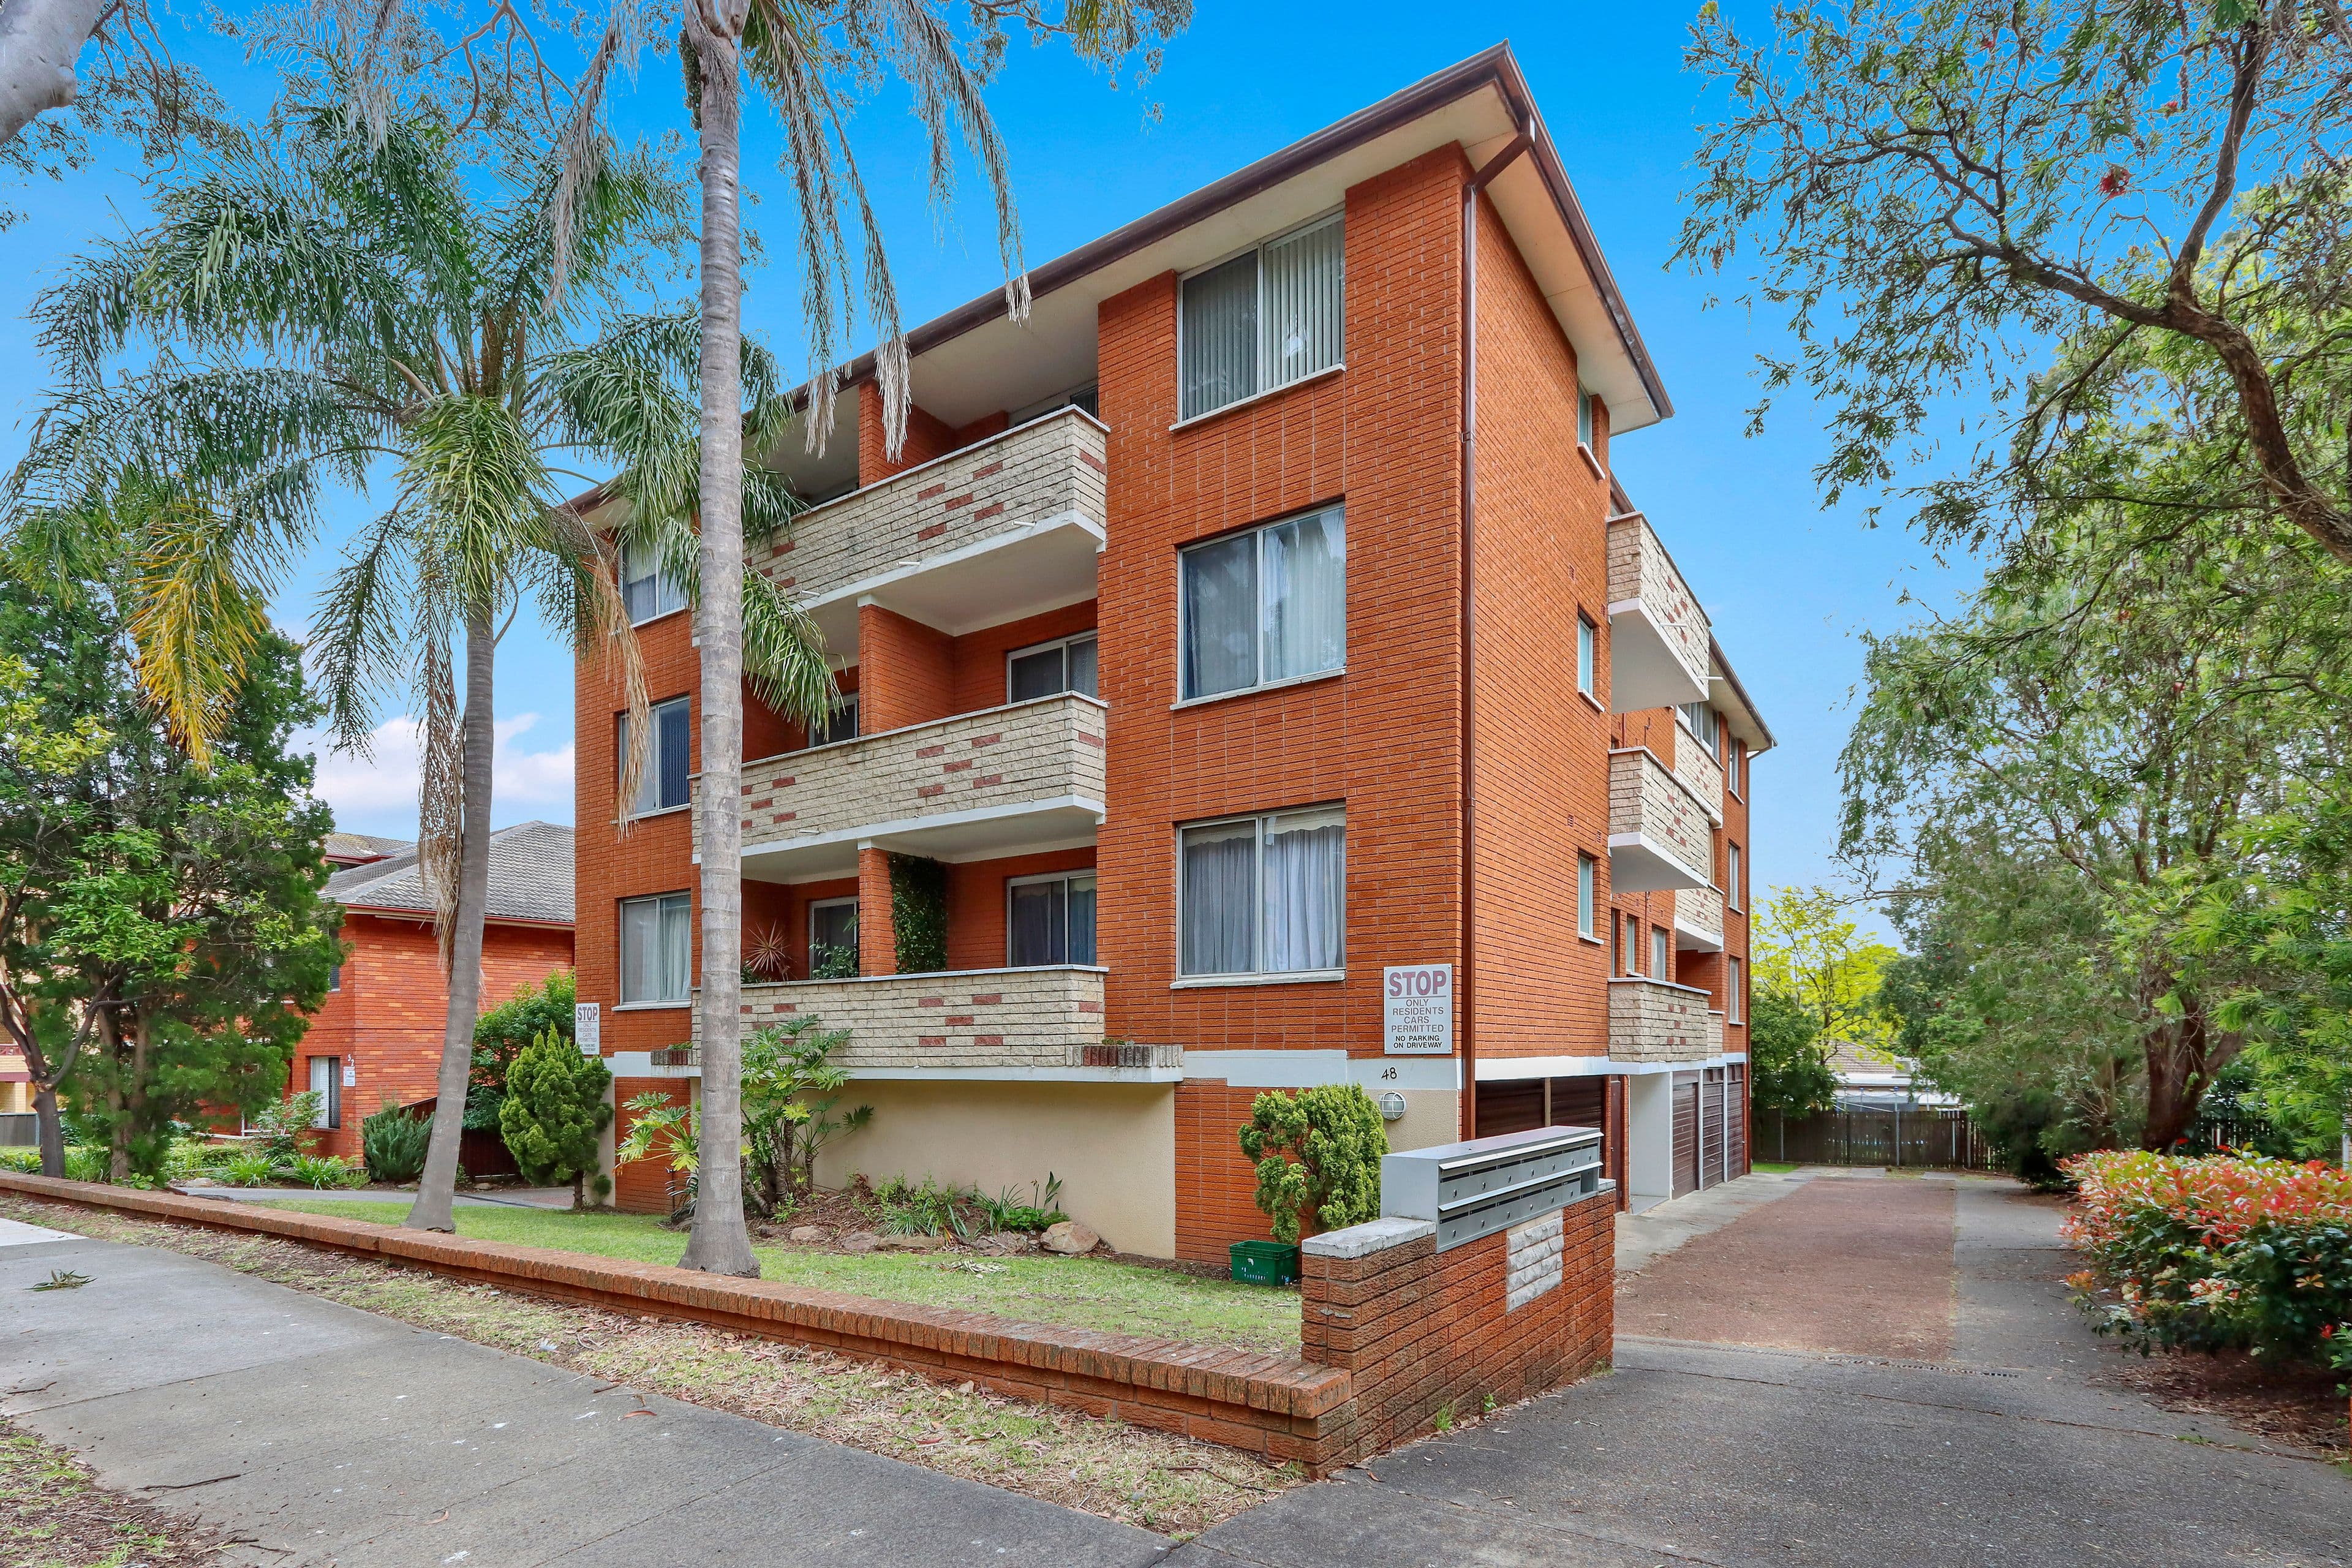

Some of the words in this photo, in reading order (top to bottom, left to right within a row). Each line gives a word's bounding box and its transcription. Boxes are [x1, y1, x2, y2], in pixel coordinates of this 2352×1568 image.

[1389, 970, 1447, 997] STOP
[1406, 998, 1429, 1007] ONLY
[578, 1006, 598, 1021] STOP
[1393, 1006, 1444, 1016] RESIDENTS
[1391, 1024, 1444, 1033] PERMITTED
[1381, 1066, 1397, 1080] 48
